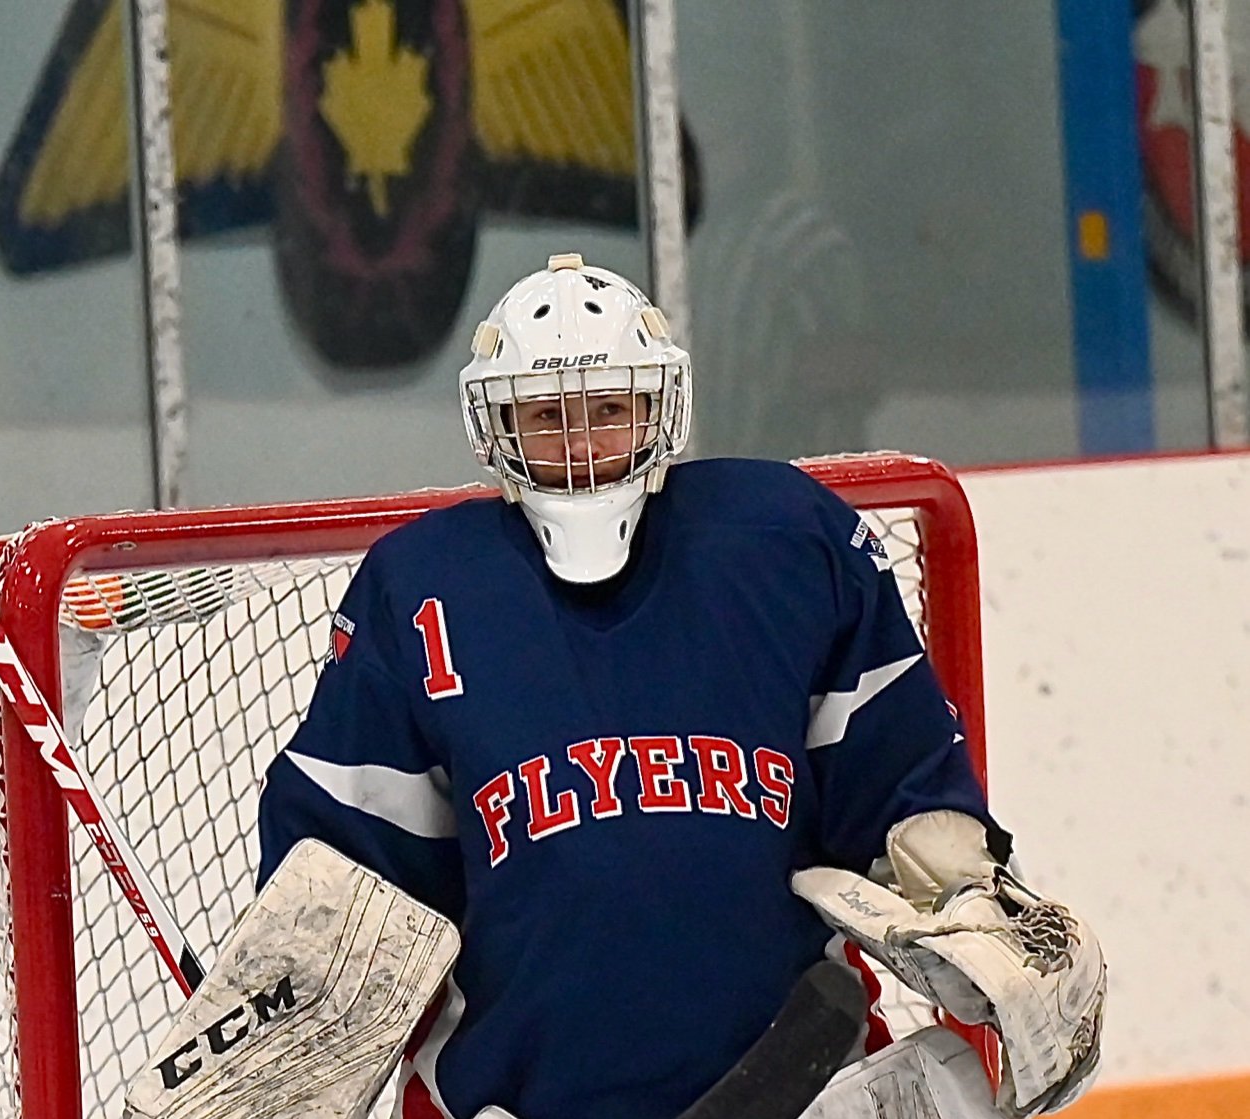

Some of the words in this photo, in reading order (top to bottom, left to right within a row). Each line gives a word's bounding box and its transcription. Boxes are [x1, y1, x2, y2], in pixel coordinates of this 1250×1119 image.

[531, 353, 608, 370] BAUER
[413, 597, 464, 700] 1
[473, 735, 795, 868] FLYERS
[152, 974, 297, 1090] CCM
